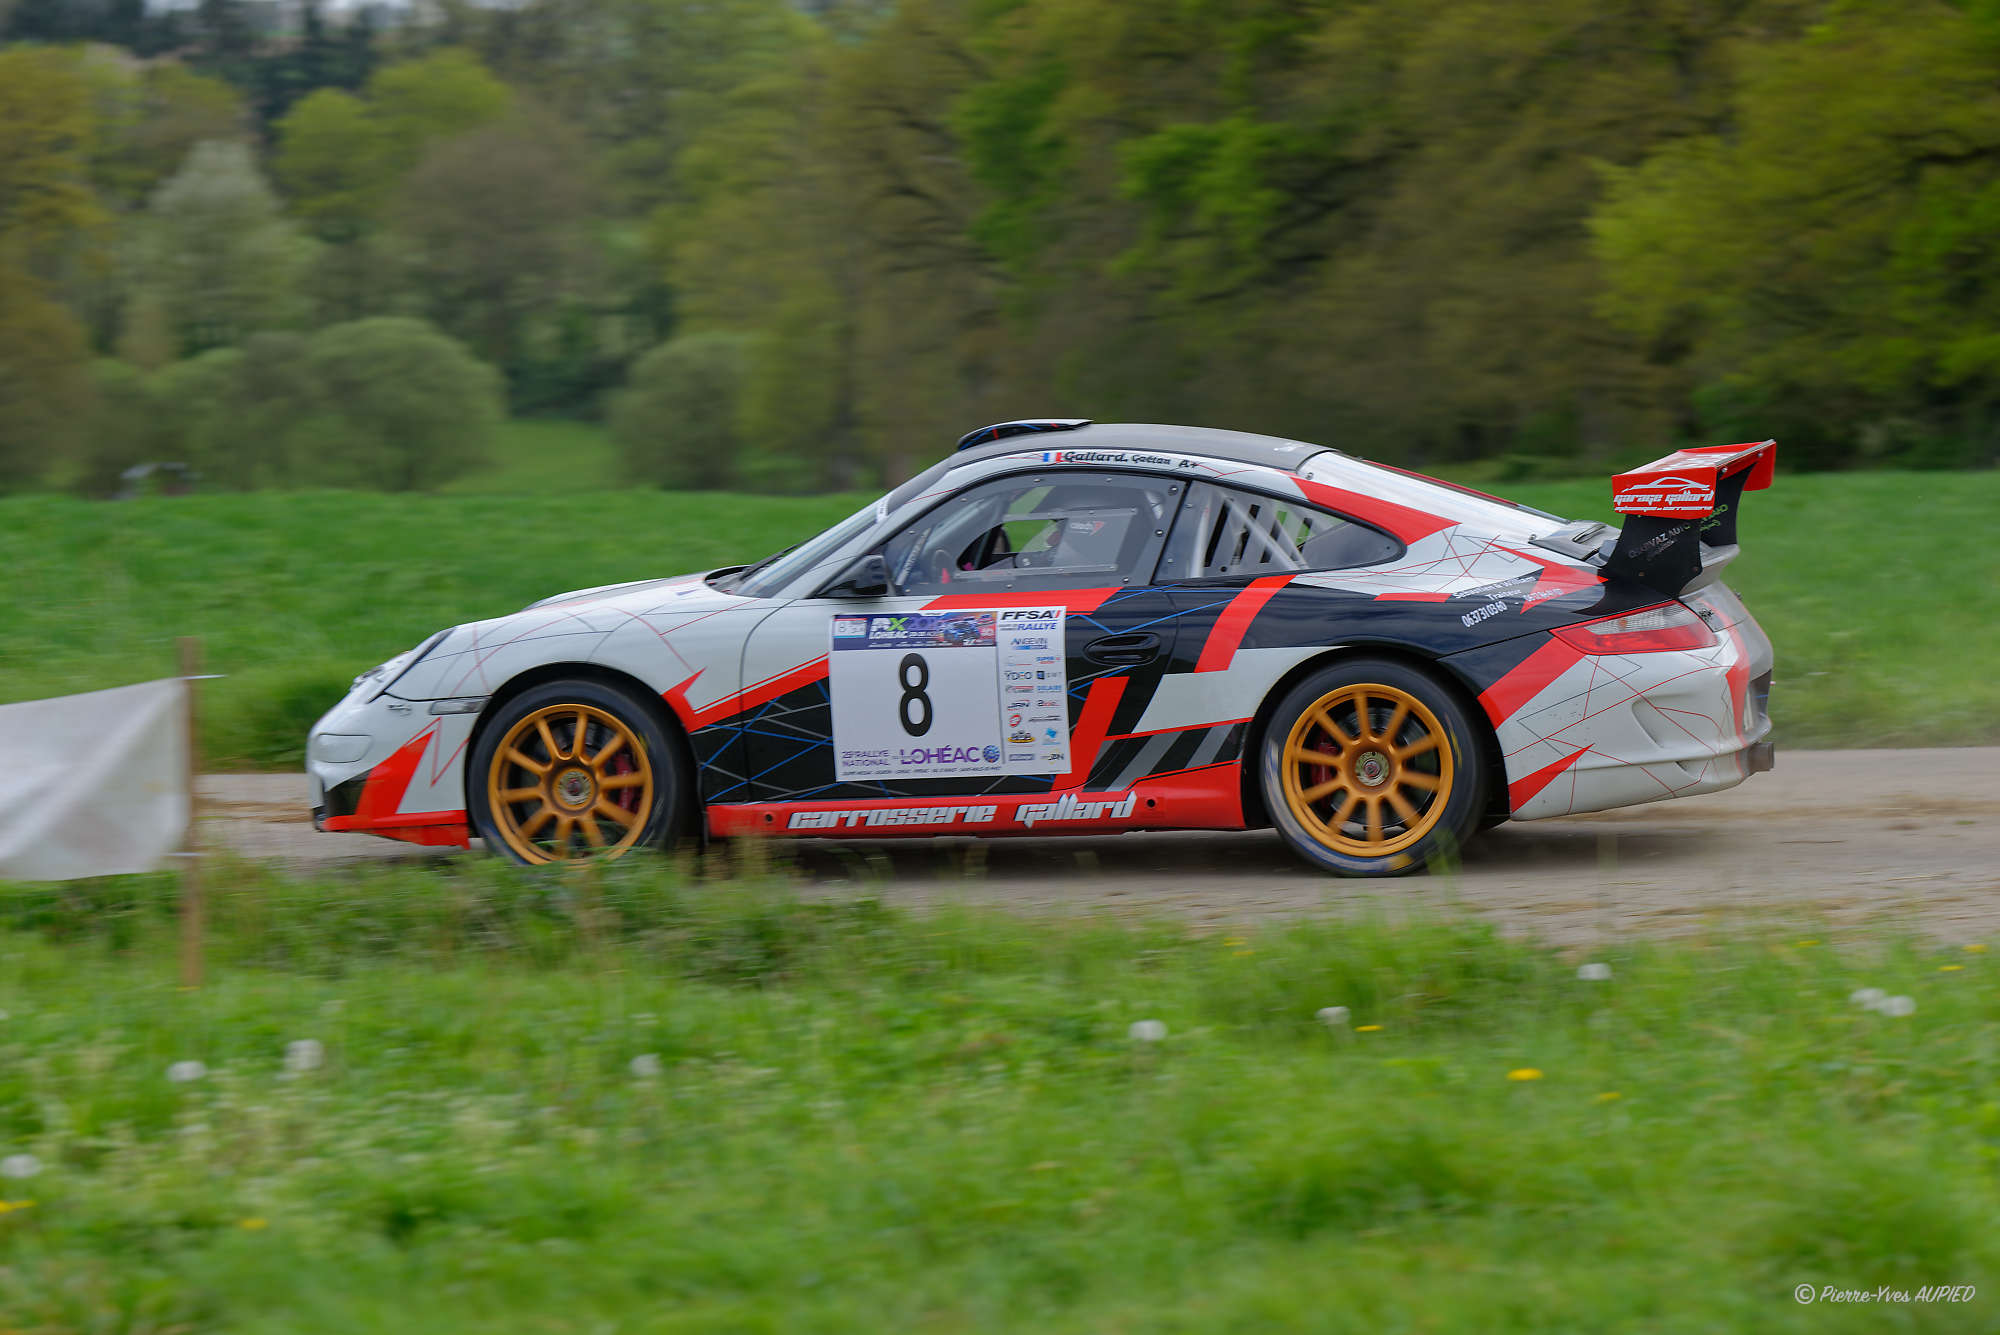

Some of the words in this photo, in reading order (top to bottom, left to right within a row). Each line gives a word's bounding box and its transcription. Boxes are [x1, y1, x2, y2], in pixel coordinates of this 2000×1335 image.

[1613, 493, 1663, 506] garage
[1001, 610, 1053, 621] FFSA
[1017, 622, 1057, 631] RALLYE
[898, 652, 933, 738] 8
[900, 744, 981, 765] LOHÉAC
[787, 804, 998, 830] carrosserie
[1014, 790, 1138, 829] gallard
